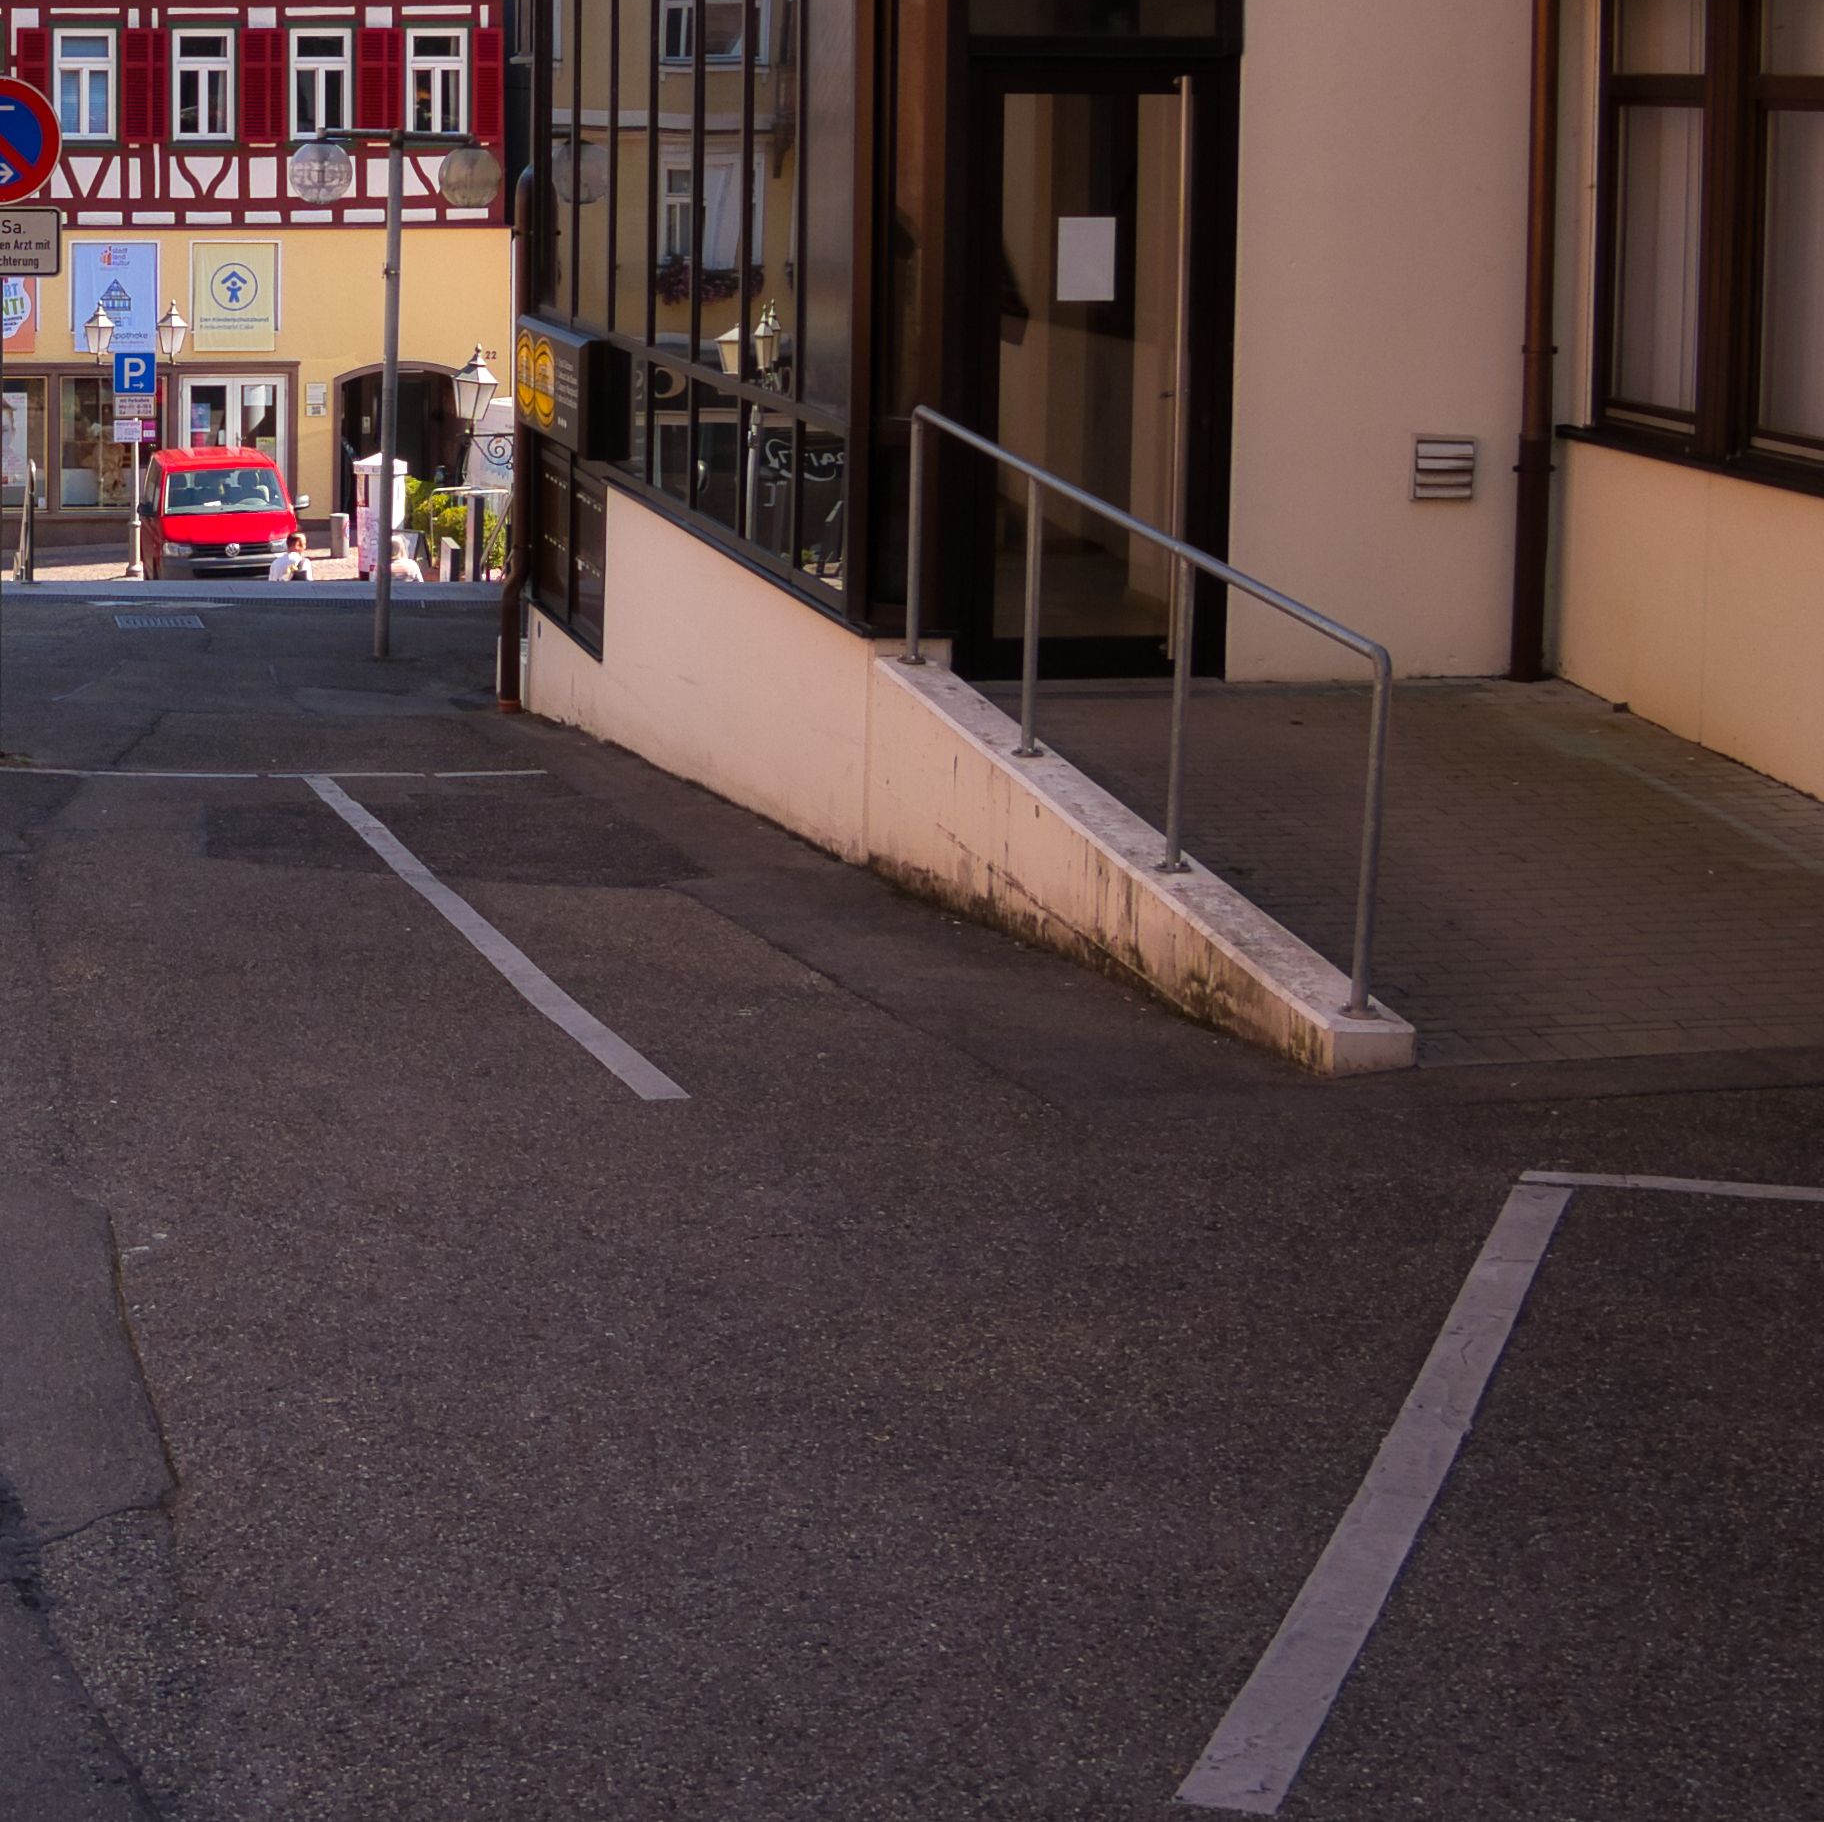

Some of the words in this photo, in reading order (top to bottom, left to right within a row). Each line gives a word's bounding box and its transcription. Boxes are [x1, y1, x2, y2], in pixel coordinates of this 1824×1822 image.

[13, 239, 32, 250] Arzt
[35, 239, 51, 250] mit
[485, 351, 497, 360] 22
[124, 358, 146, 389] P
